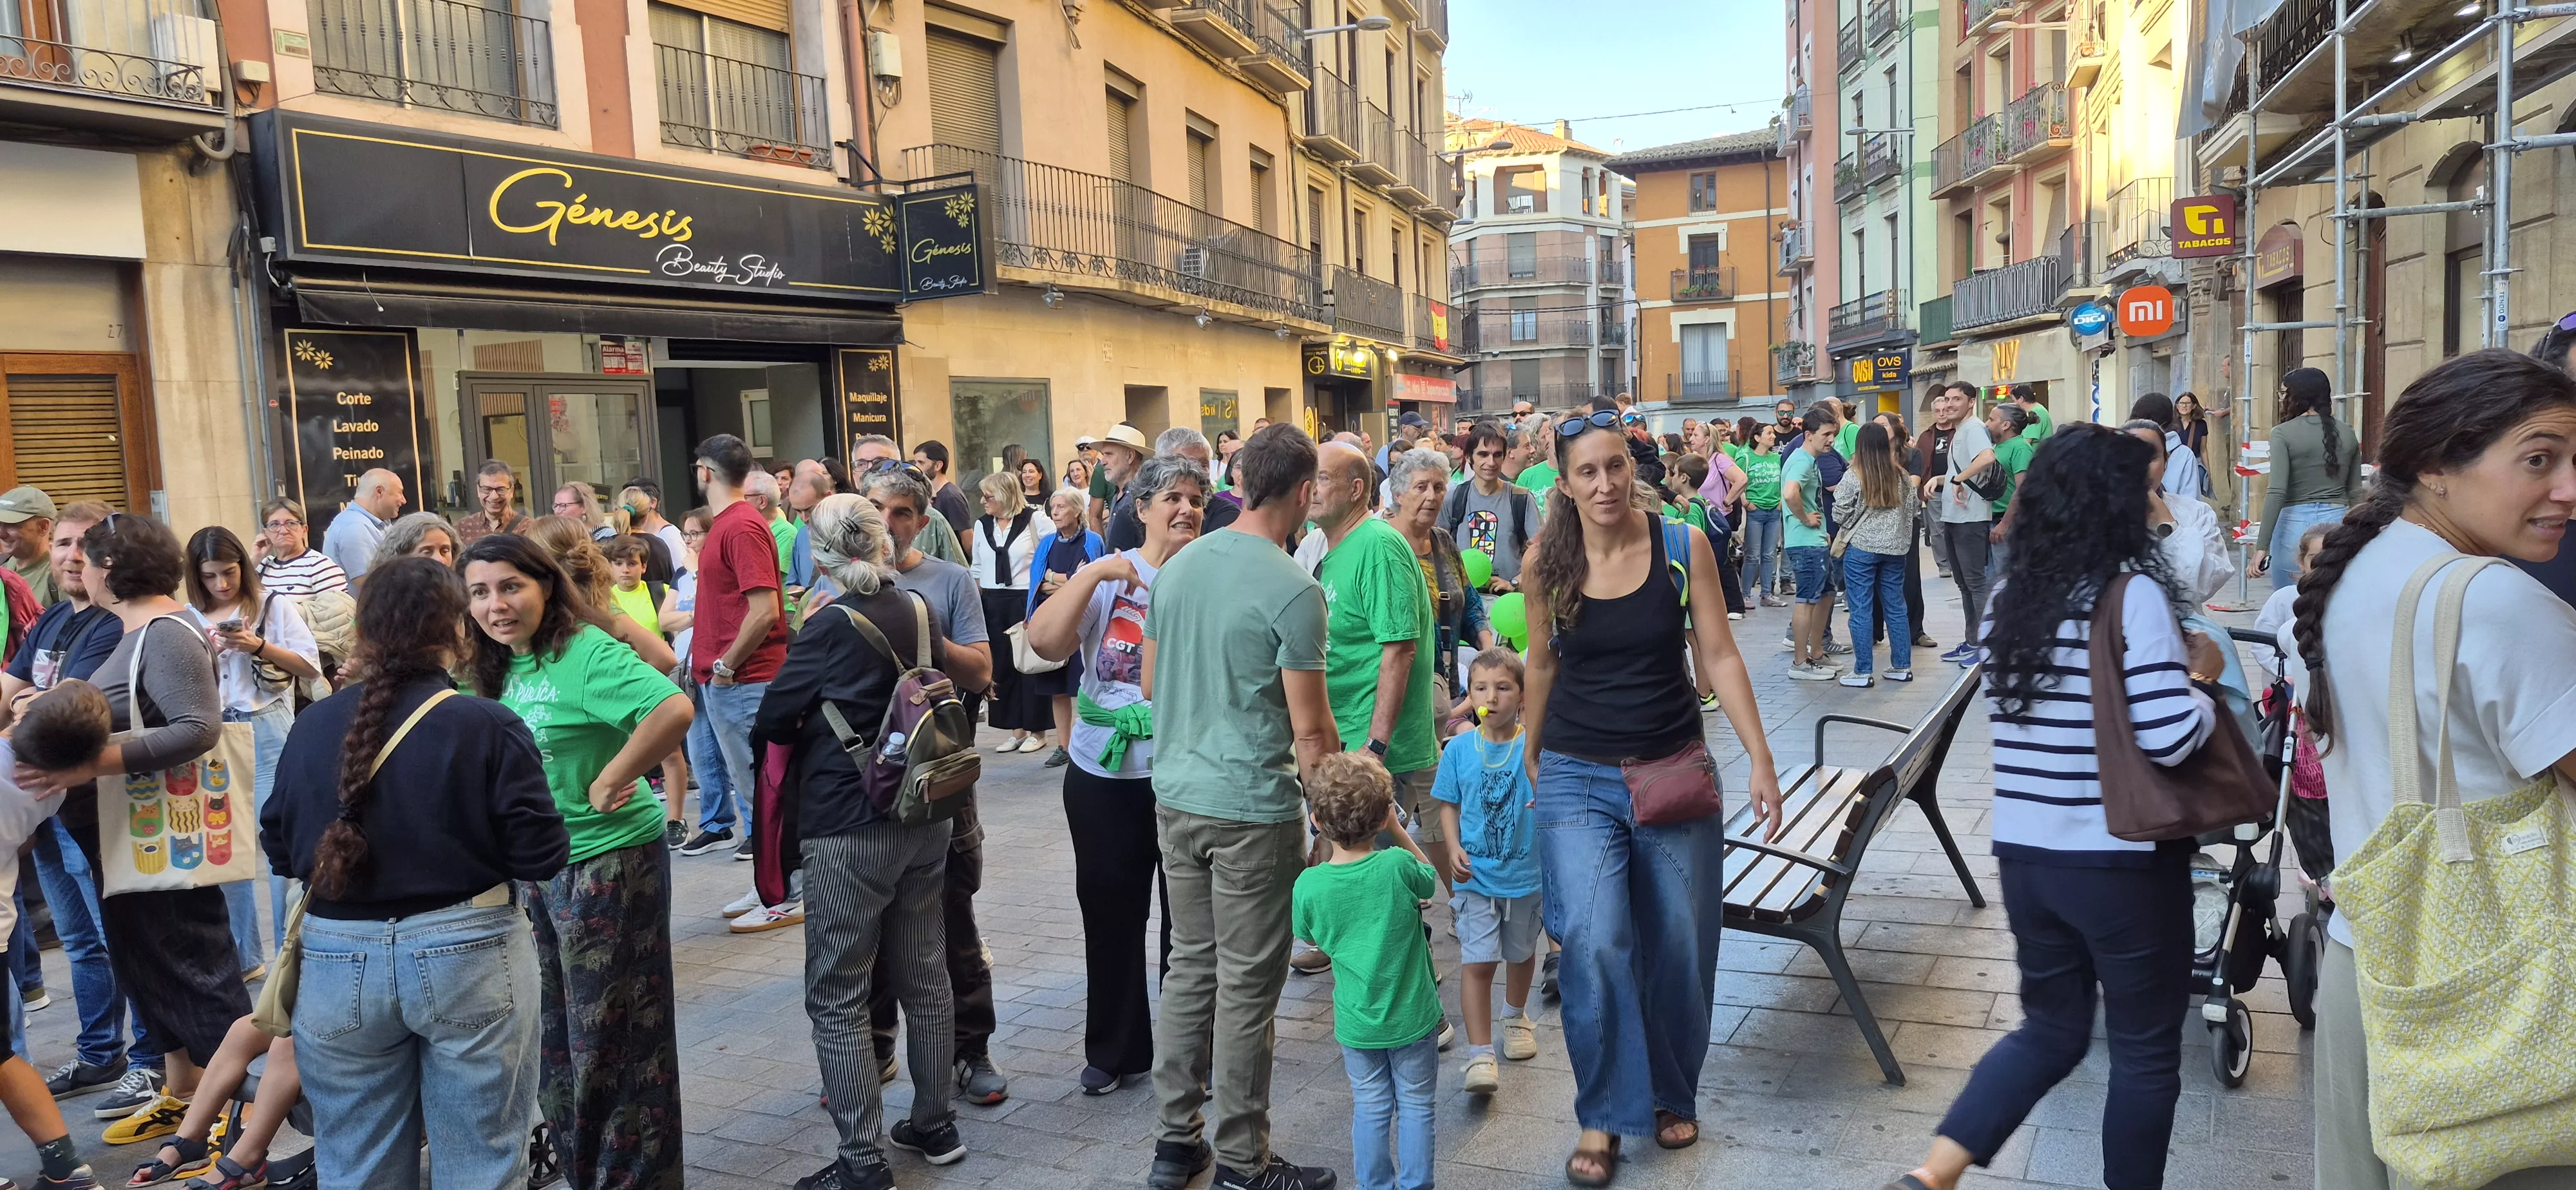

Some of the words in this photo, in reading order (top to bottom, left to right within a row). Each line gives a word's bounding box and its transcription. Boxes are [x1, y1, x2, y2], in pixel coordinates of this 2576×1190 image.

[489, 167, 693, 246] Génesis
[2178, 238, 2231, 249] TABACOS
[911, 238, 972, 264] Génesis
[2267, 245, 2289, 269] TABACOS
[656, 243, 735, 283] Beauty
[735, 254, 786, 287] Studio
[920, 277, 949, 290] Beauty
[2074, 314, 2105, 325] DIGI
[1877, 355, 1901, 367] OVS
[337, 392, 372, 405] Corte
[849, 392, 887, 404] Maquillaje
[853, 413, 887, 422] Manicura
[333, 419, 379, 433] Lavado
[333, 446, 384, 460] Peinado
[1107, 638, 1135, 653] CGT
